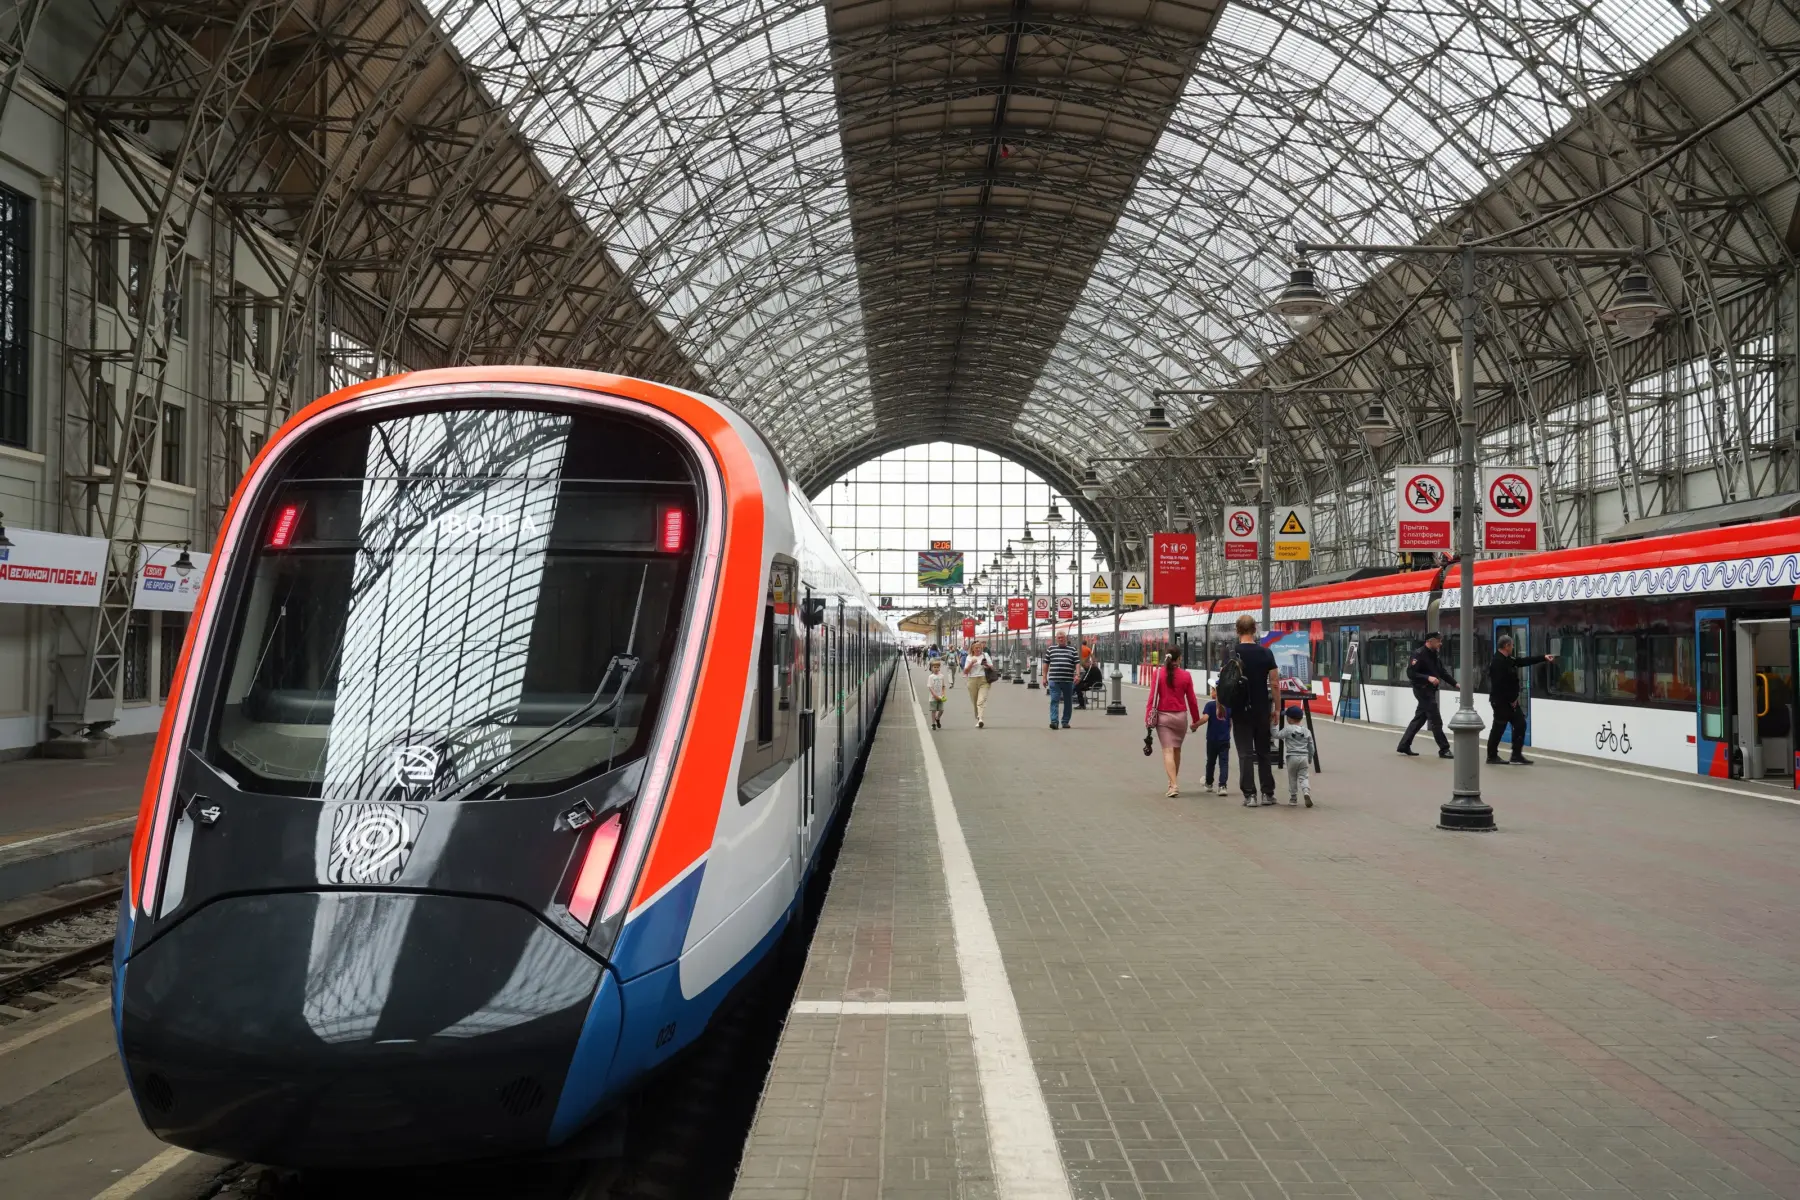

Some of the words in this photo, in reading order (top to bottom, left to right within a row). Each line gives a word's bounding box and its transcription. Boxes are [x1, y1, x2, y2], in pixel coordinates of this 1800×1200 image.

[427, 511, 538, 535] ИВОЛГА
[1403, 524, 1429, 532] Прыгать
[10, 567, 48, 581] ВЕЛИКОЙ
[49, 568, 98, 586] ПОБЕДЫ
[146, 566, 163, 577] СВОИХ
[145, 581, 153, 589] НЕ
[153, 582, 174, 591] БРОСАЕМ
[884, 597, 890, 605] 7
